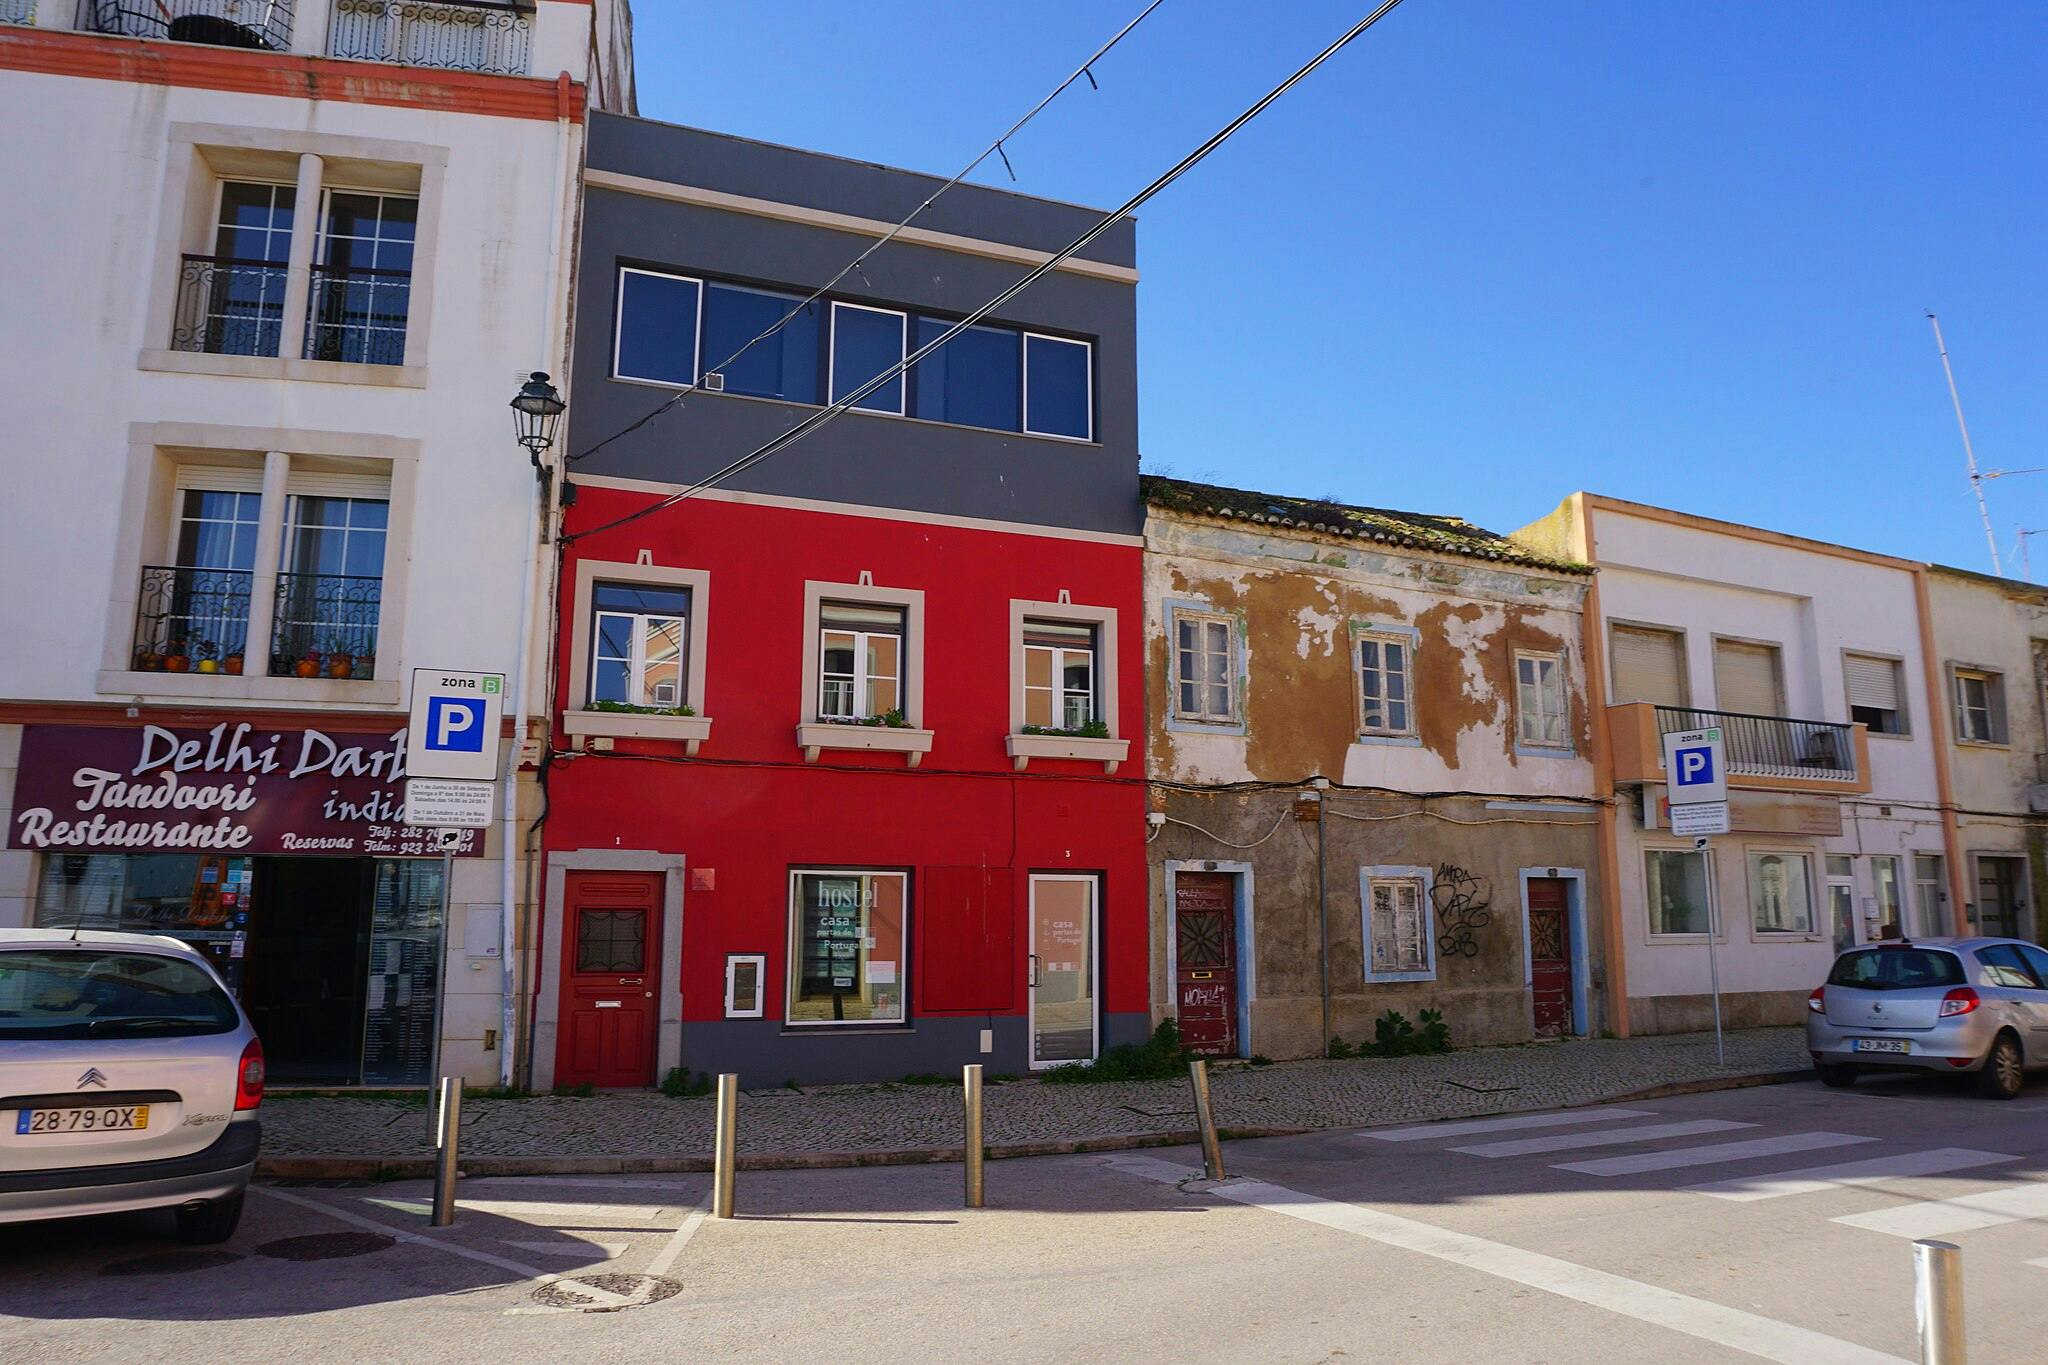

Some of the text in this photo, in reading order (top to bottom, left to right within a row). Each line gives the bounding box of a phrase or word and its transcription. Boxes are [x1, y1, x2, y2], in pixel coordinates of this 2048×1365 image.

[441, 677, 497, 694] zona B
[437, 703, 474, 745] P
[1681, 734, 1703, 743] zona
[132, 723, 280, 776] Delhi
[1682, 752, 1706, 782] P
[72, 767, 257, 811] Tandoori
[18, 807, 253, 848] Restaurante
[400, 827, 423, 838] 282
[281, 832, 354, 850] Reservas
[364, 840, 397, 852] Telm:
[399, 842, 423, 855] 923
[616, 836, 620, 845] 1
[818, 880, 879, 908] hostel
[820, 917, 850, 926] casa
[32, 1109, 136, 1131] 28-79-QX
